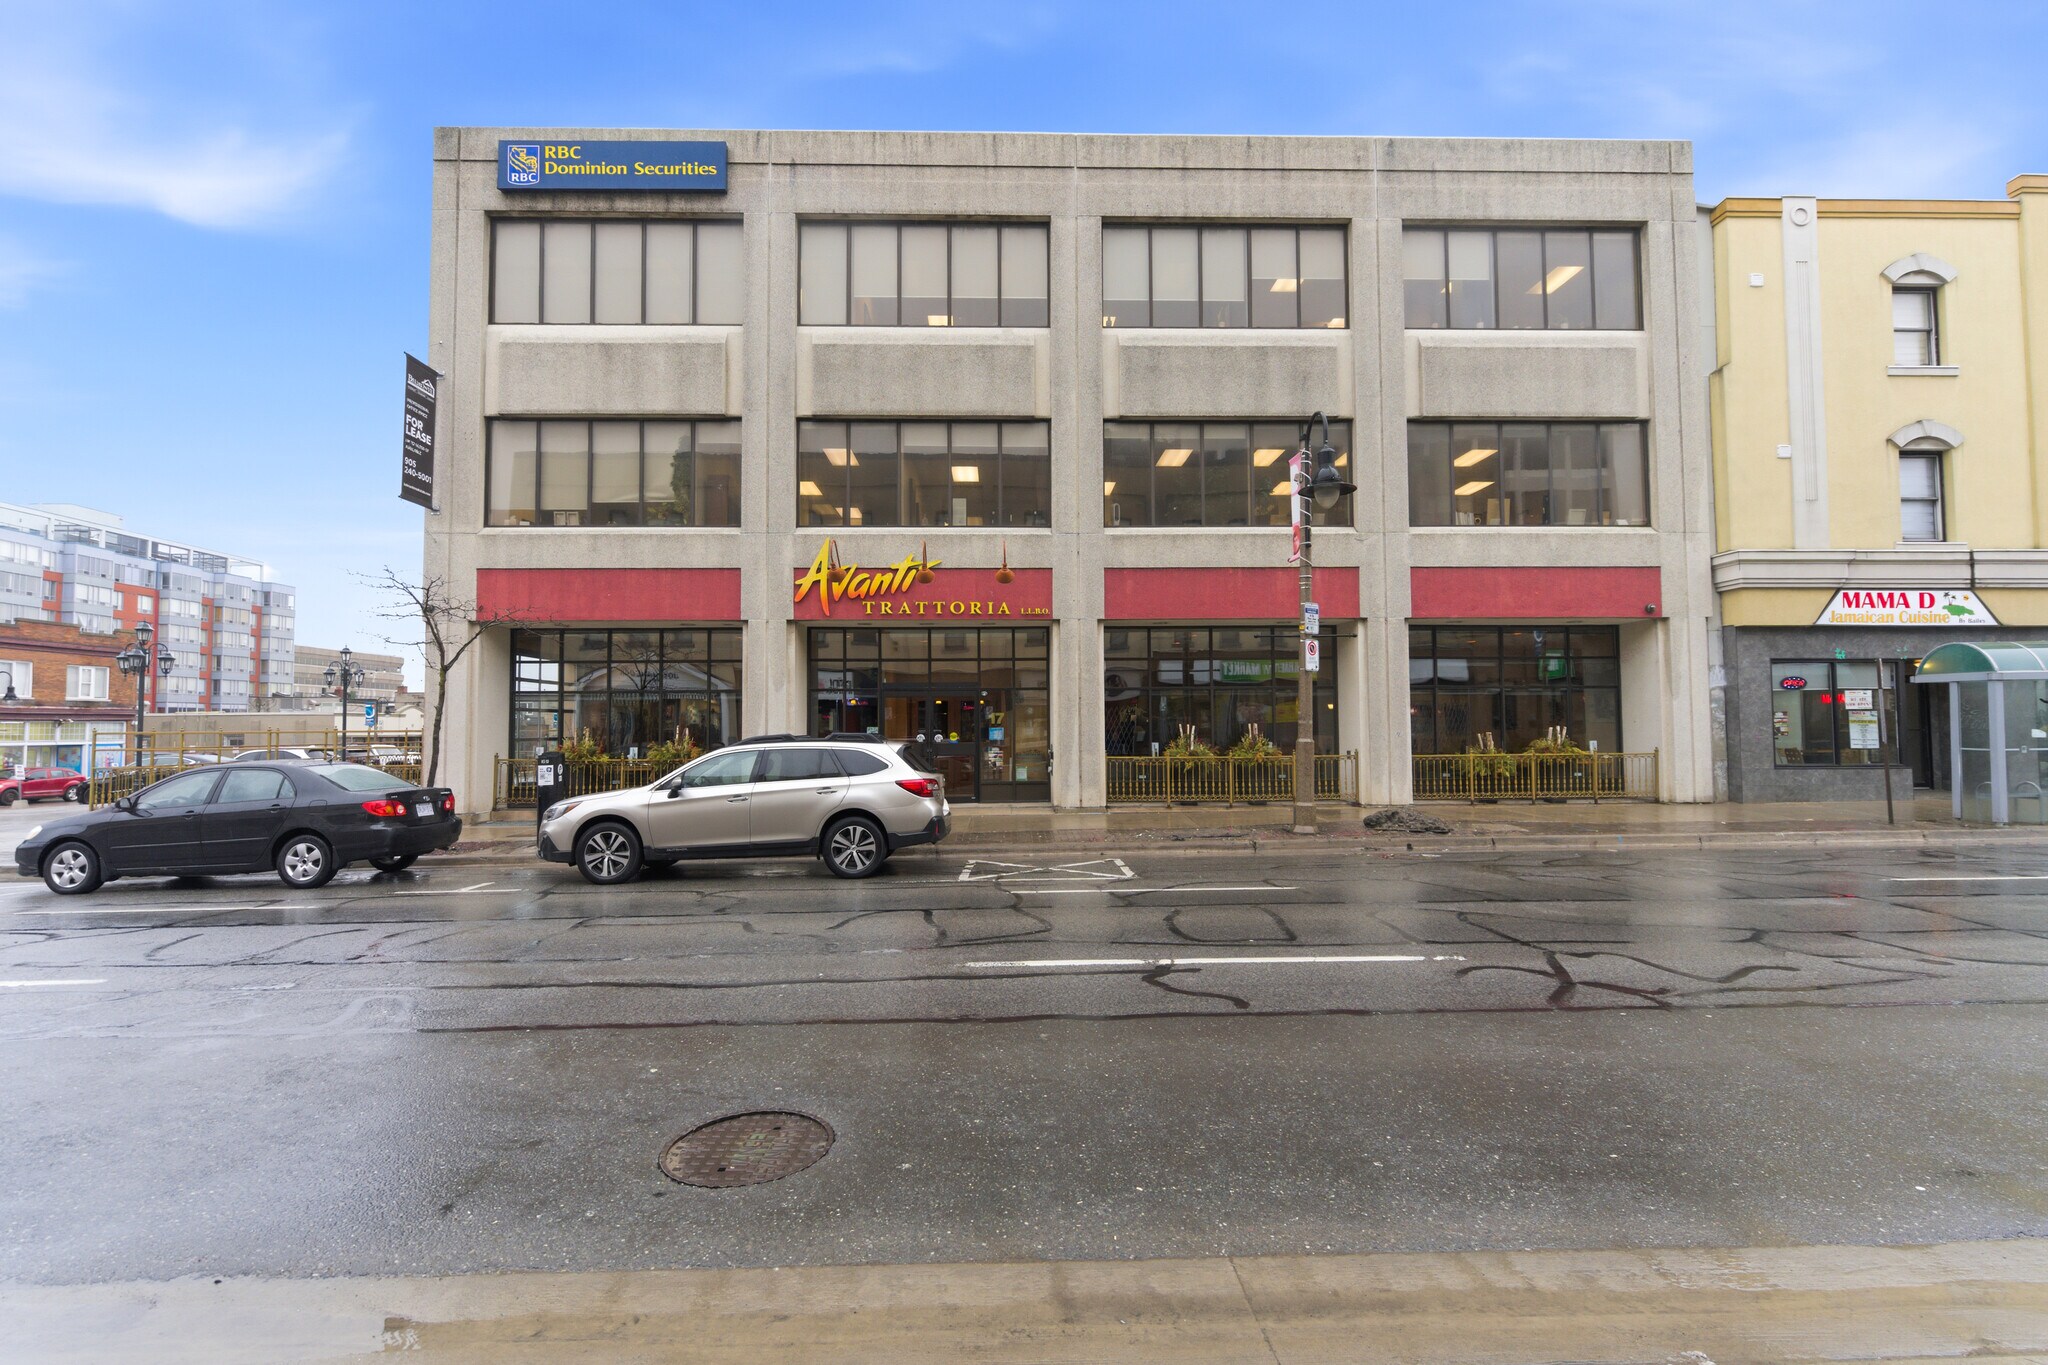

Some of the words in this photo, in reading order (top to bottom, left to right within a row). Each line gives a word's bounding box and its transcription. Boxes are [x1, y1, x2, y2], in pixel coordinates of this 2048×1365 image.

[544, 145, 582, 160] RBC
[544, 161, 628, 175] Dominion
[634, 161, 718, 175] Securities
[511, 172, 537, 182] RBC
[405, 413, 423, 431] FOR
[405, 424, 432, 446] LEASE
[404, 456, 417, 468] 905
[403, 465, 432, 484] 240-5001
[794, 536, 942, 617] Avanti
[862, 600, 1011, 616] TRATTORIA
[1842, 591, 1911, 609] MAMA
[1918, 592, 1936, 609] D
[1828, 610, 1894, 623] Jamaican
[1898, 610, 1951, 623] Cuisine
